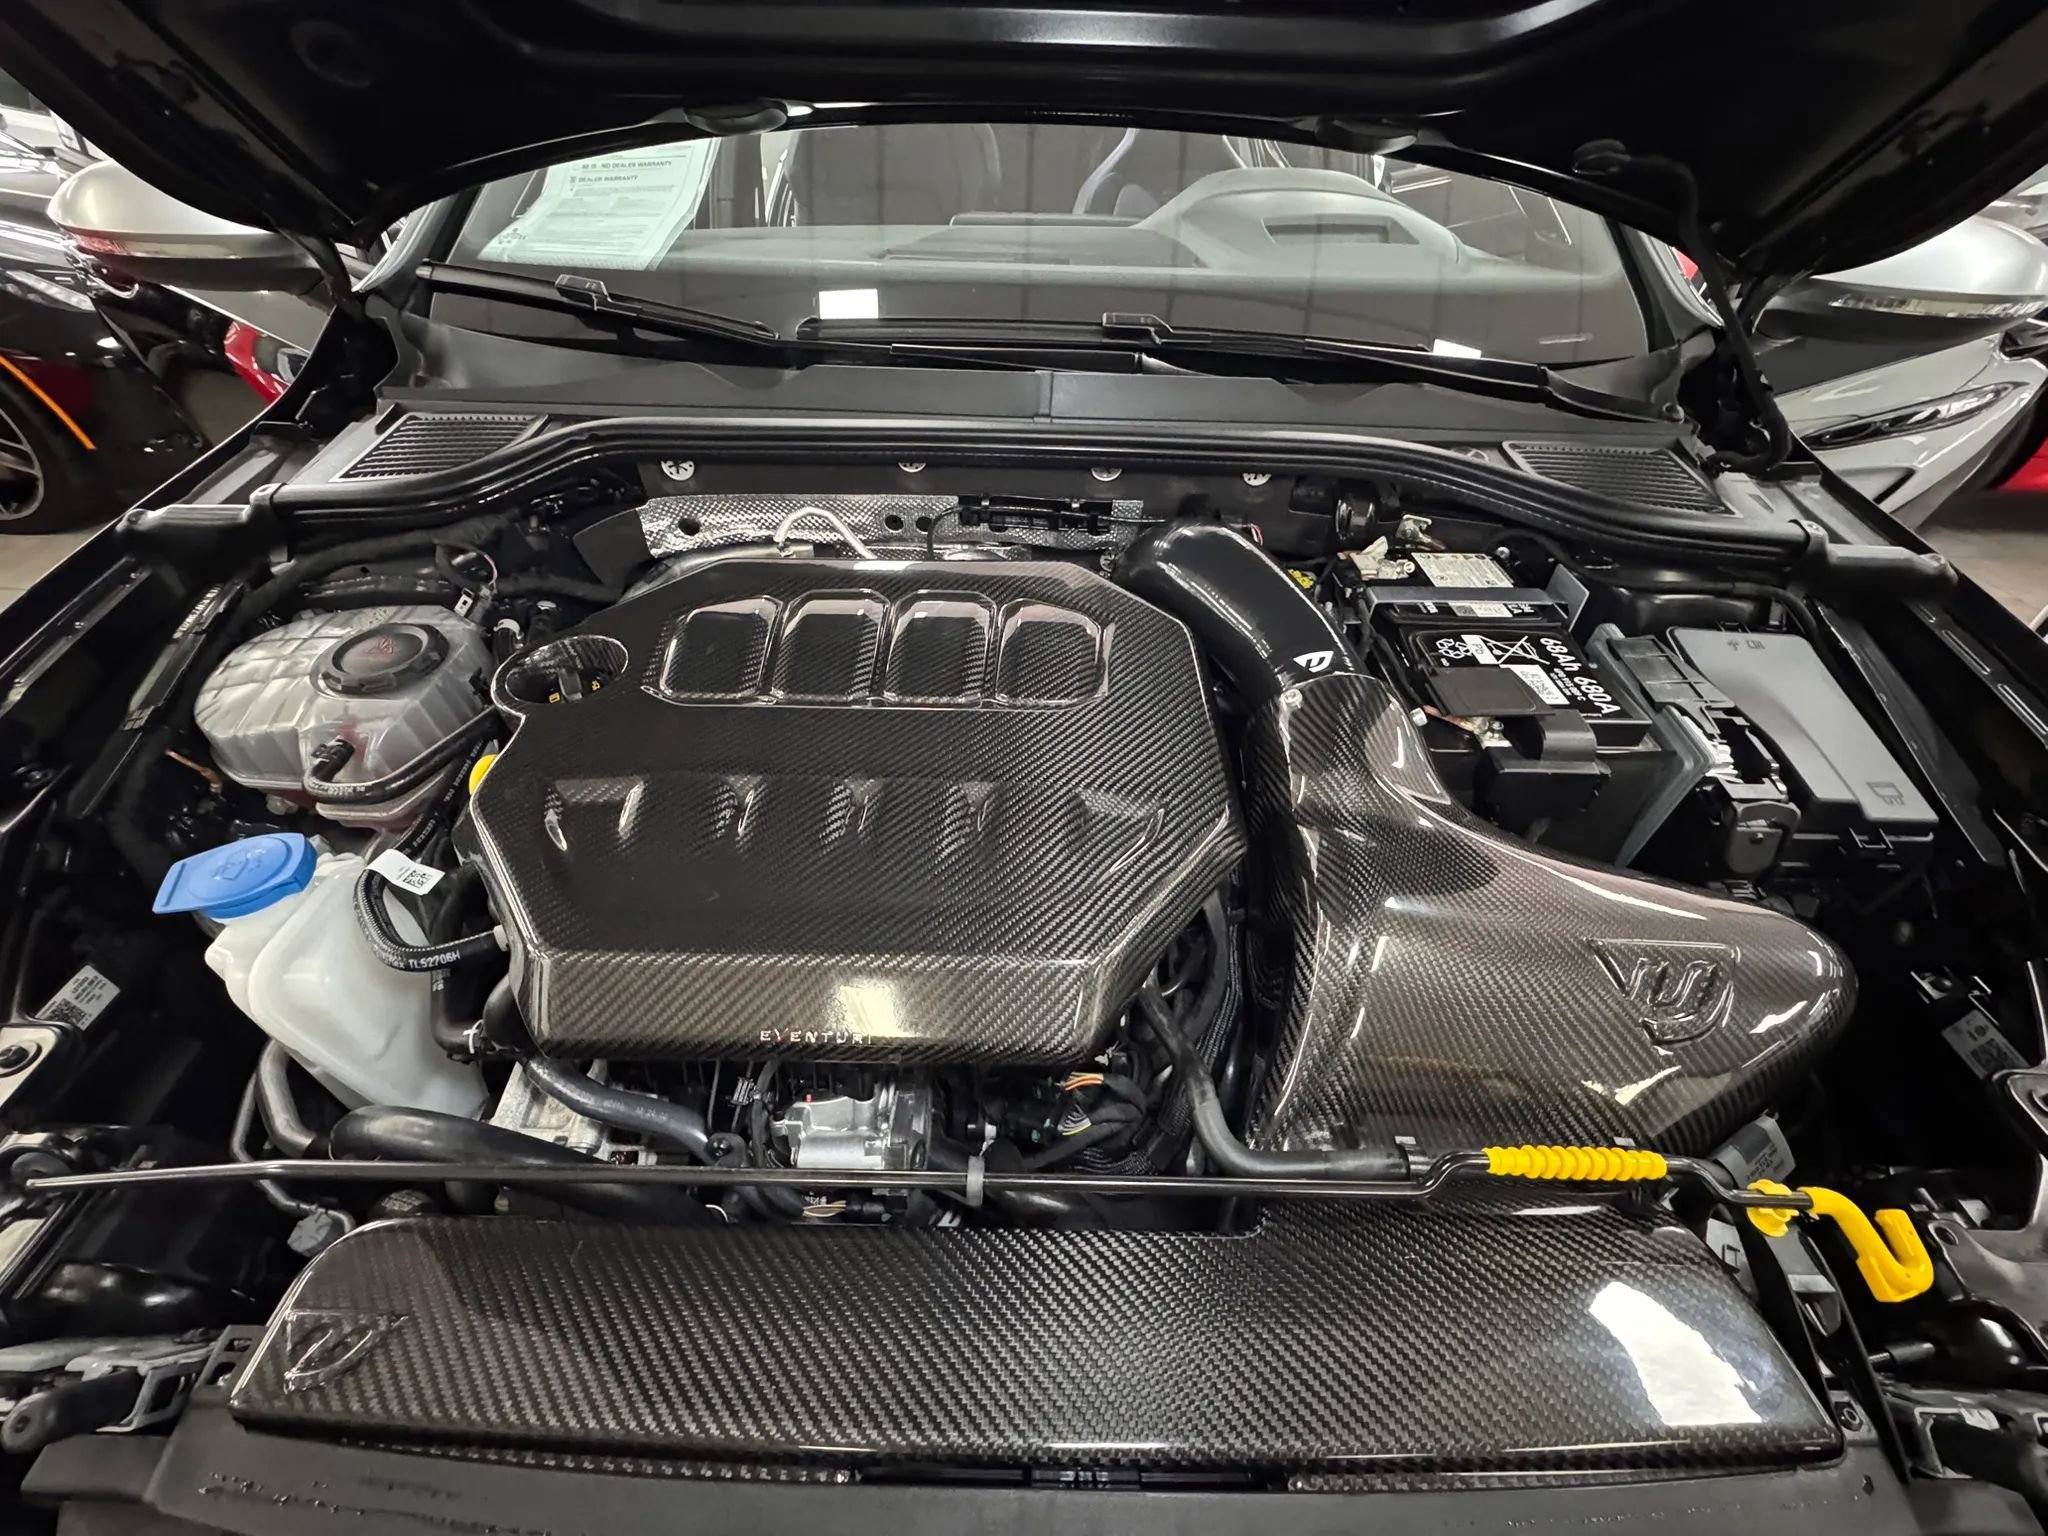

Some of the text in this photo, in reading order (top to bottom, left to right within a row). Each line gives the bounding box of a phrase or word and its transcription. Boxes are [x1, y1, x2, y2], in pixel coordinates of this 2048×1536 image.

[1539, 637, 1582, 672] 68Ah
[1573, 676, 1621, 714] 680A
[759, 1028, 872, 1044] EVENTURI
